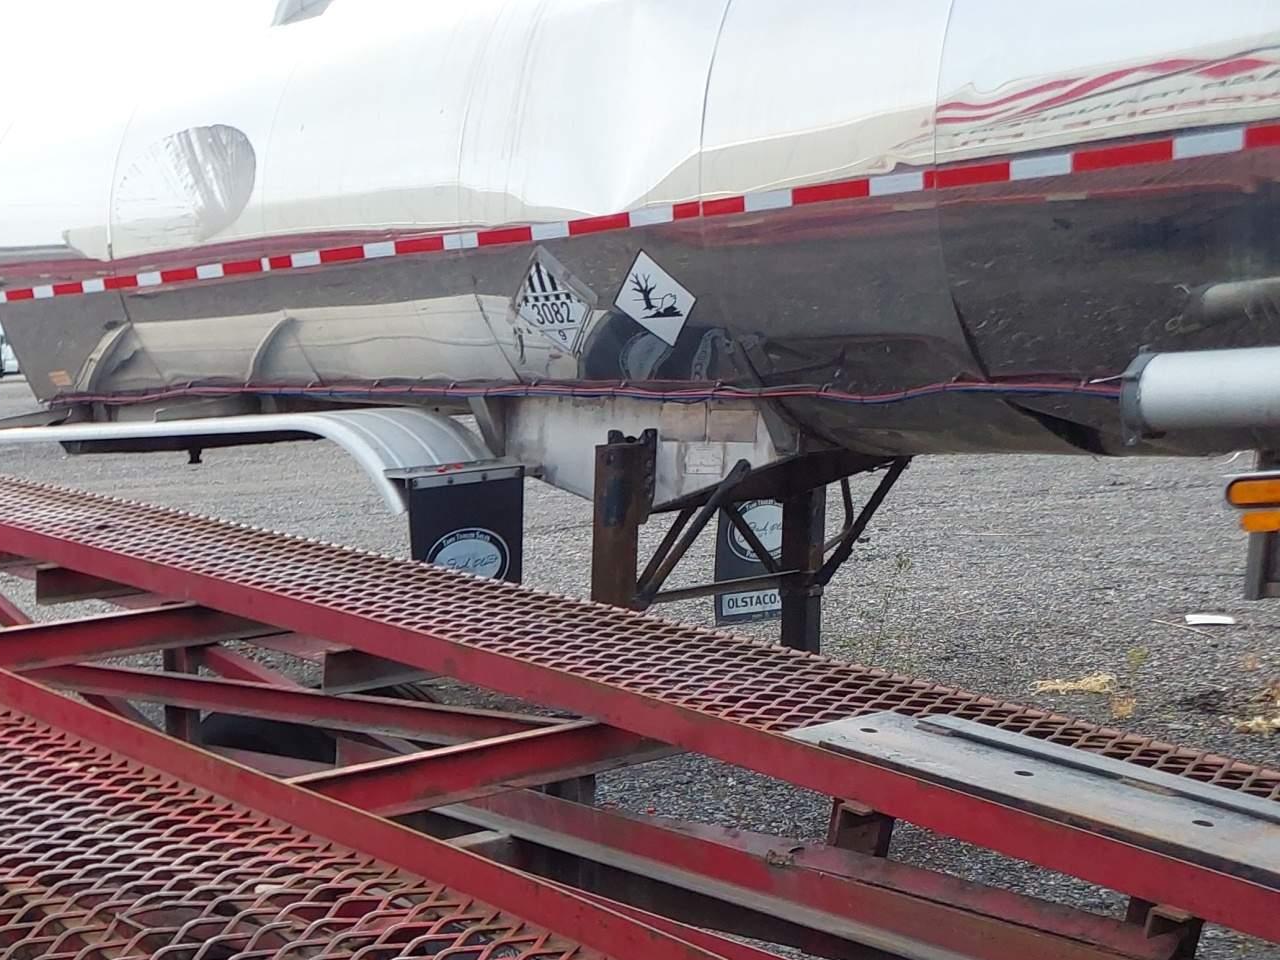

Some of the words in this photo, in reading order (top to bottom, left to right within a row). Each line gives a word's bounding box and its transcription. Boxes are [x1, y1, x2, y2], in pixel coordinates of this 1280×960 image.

[531, 301, 575, 326] 3082
[557, 330, 567, 341] 9
[727, 592, 780, 609] OLSTACO.
